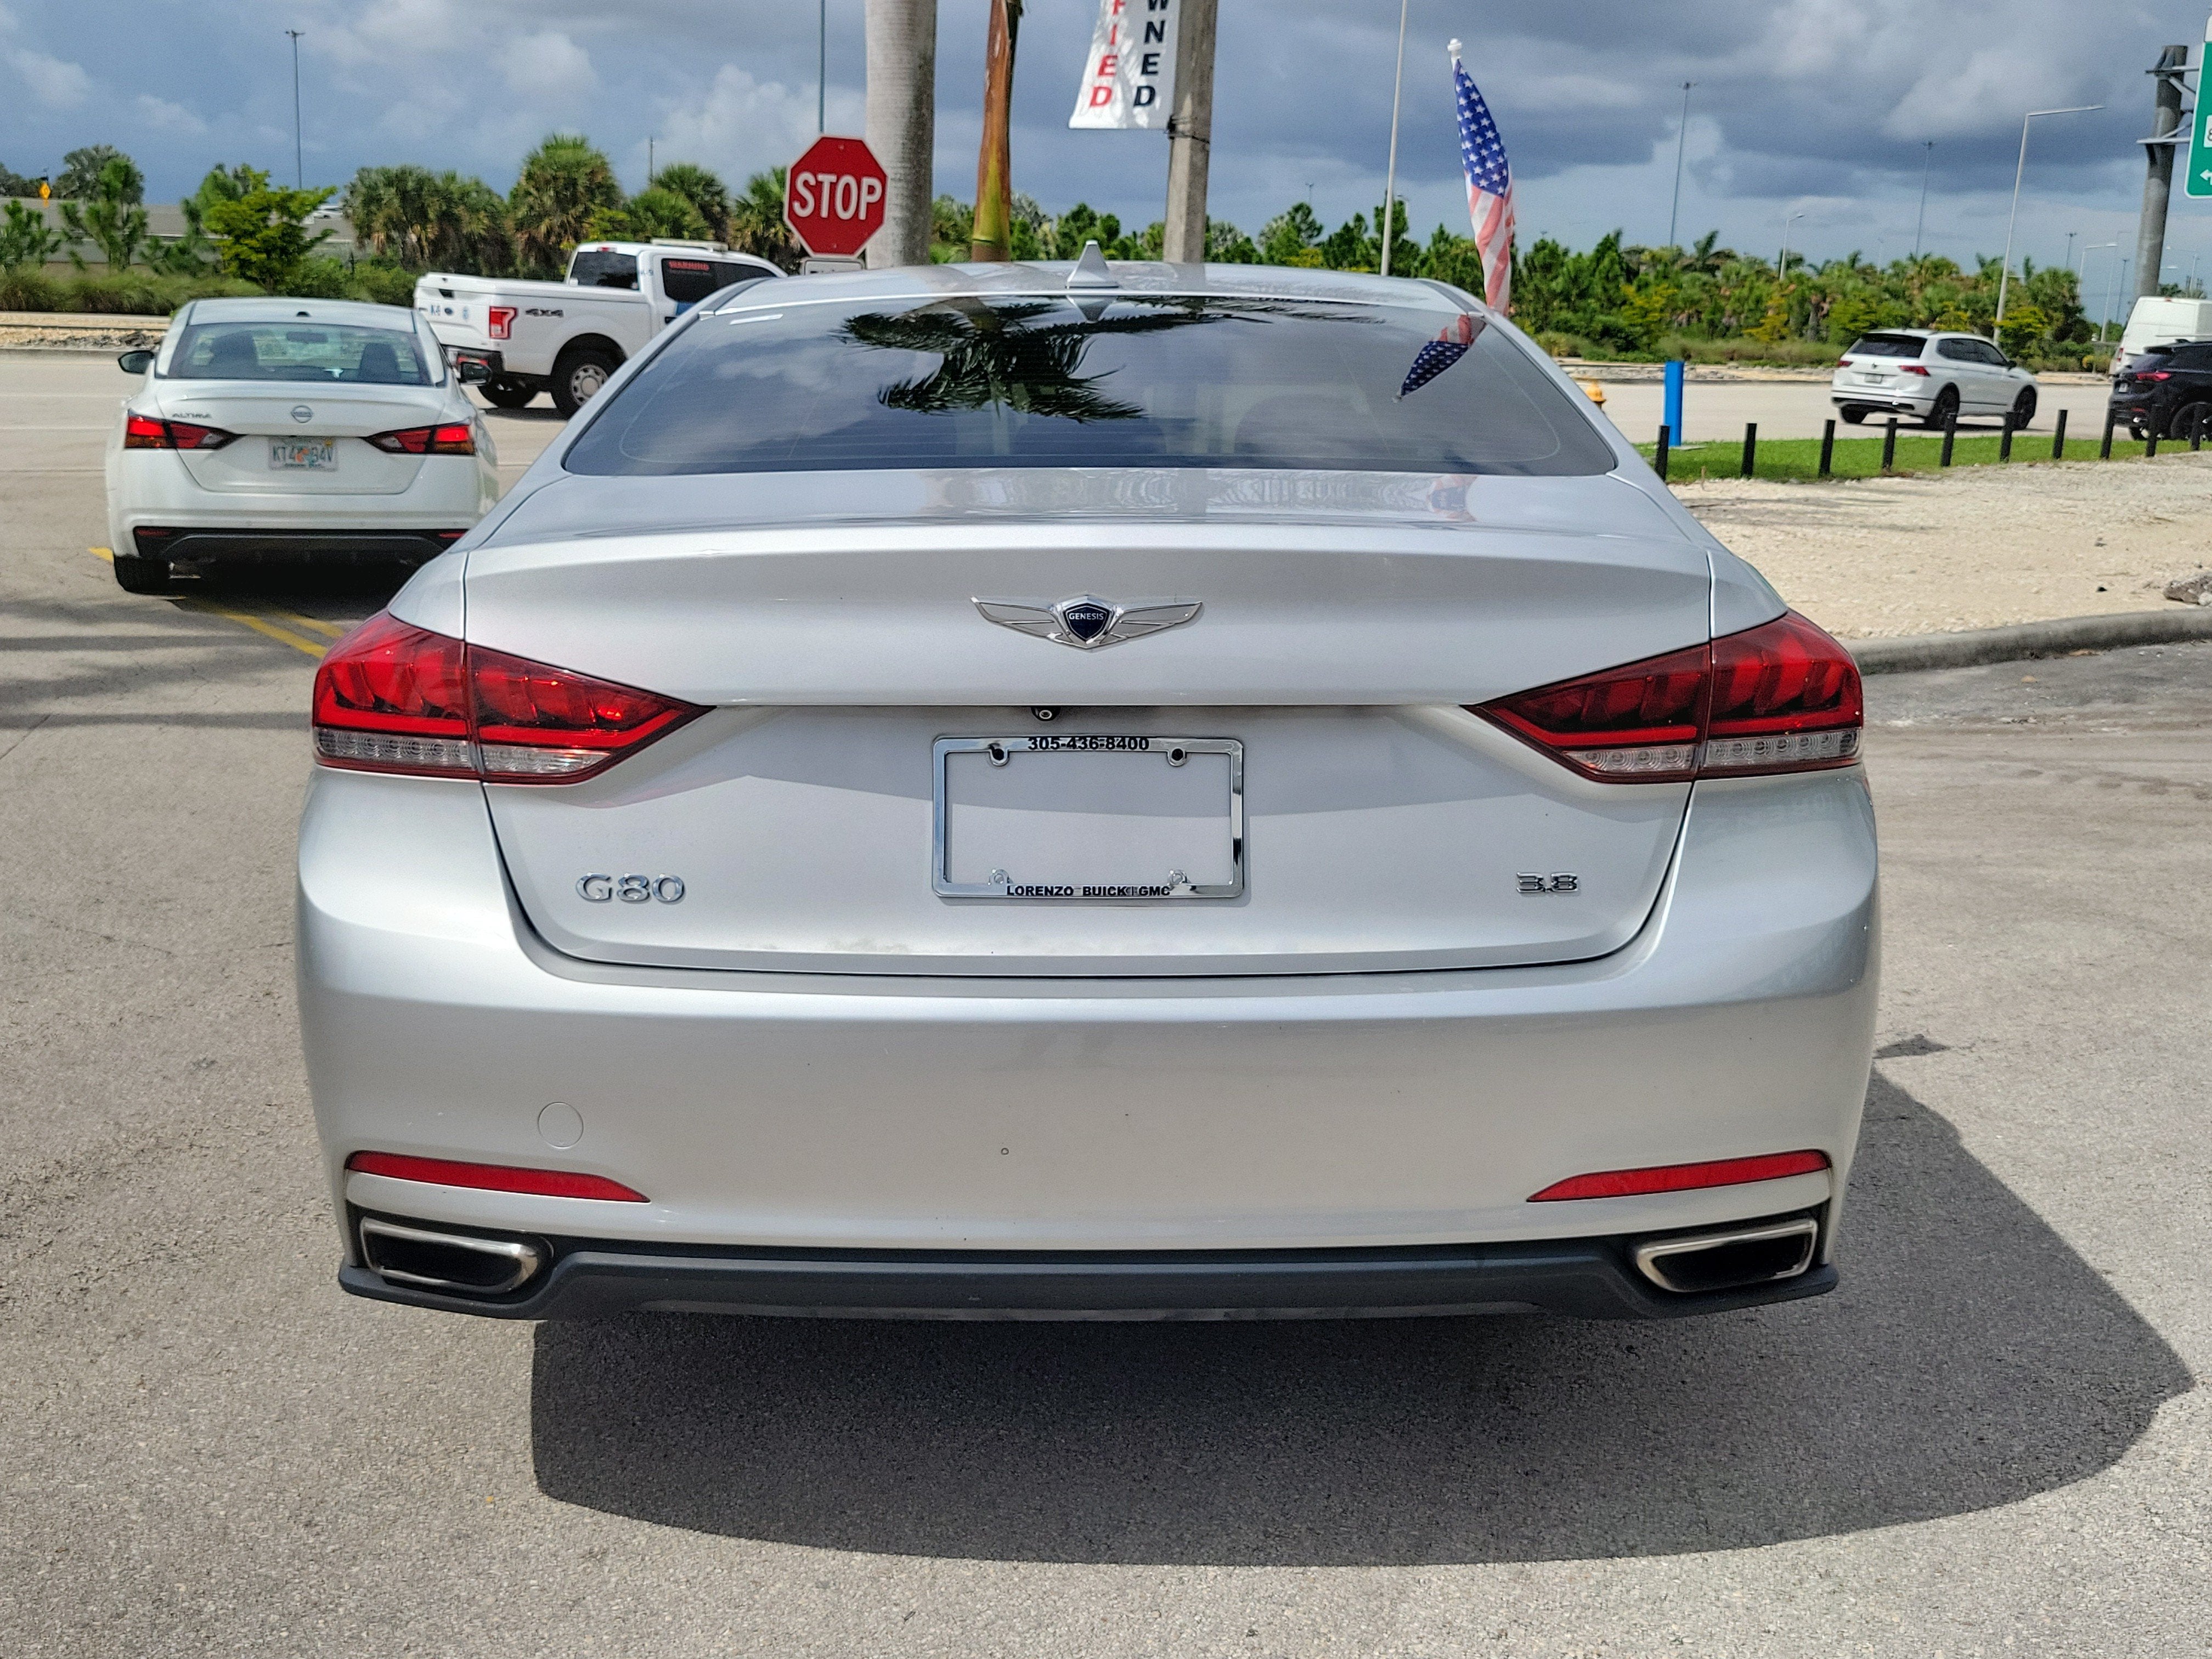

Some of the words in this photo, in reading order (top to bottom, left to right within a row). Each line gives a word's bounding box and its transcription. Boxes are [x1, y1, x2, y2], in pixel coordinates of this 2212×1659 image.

[792, 171, 882, 220] STOP
[1069, 612, 1104, 620] GENESIS
[1028, 736, 1149, 751] 305-436-8400
[576, 872, 685, 904] G80
[1007, 885, 1074, 896] LORENZO
[1082, 885, 1127, 896] BUICK
[1138, 885, 1171, 896] GMC
[1516, 871, 1578, 894] 3.8
